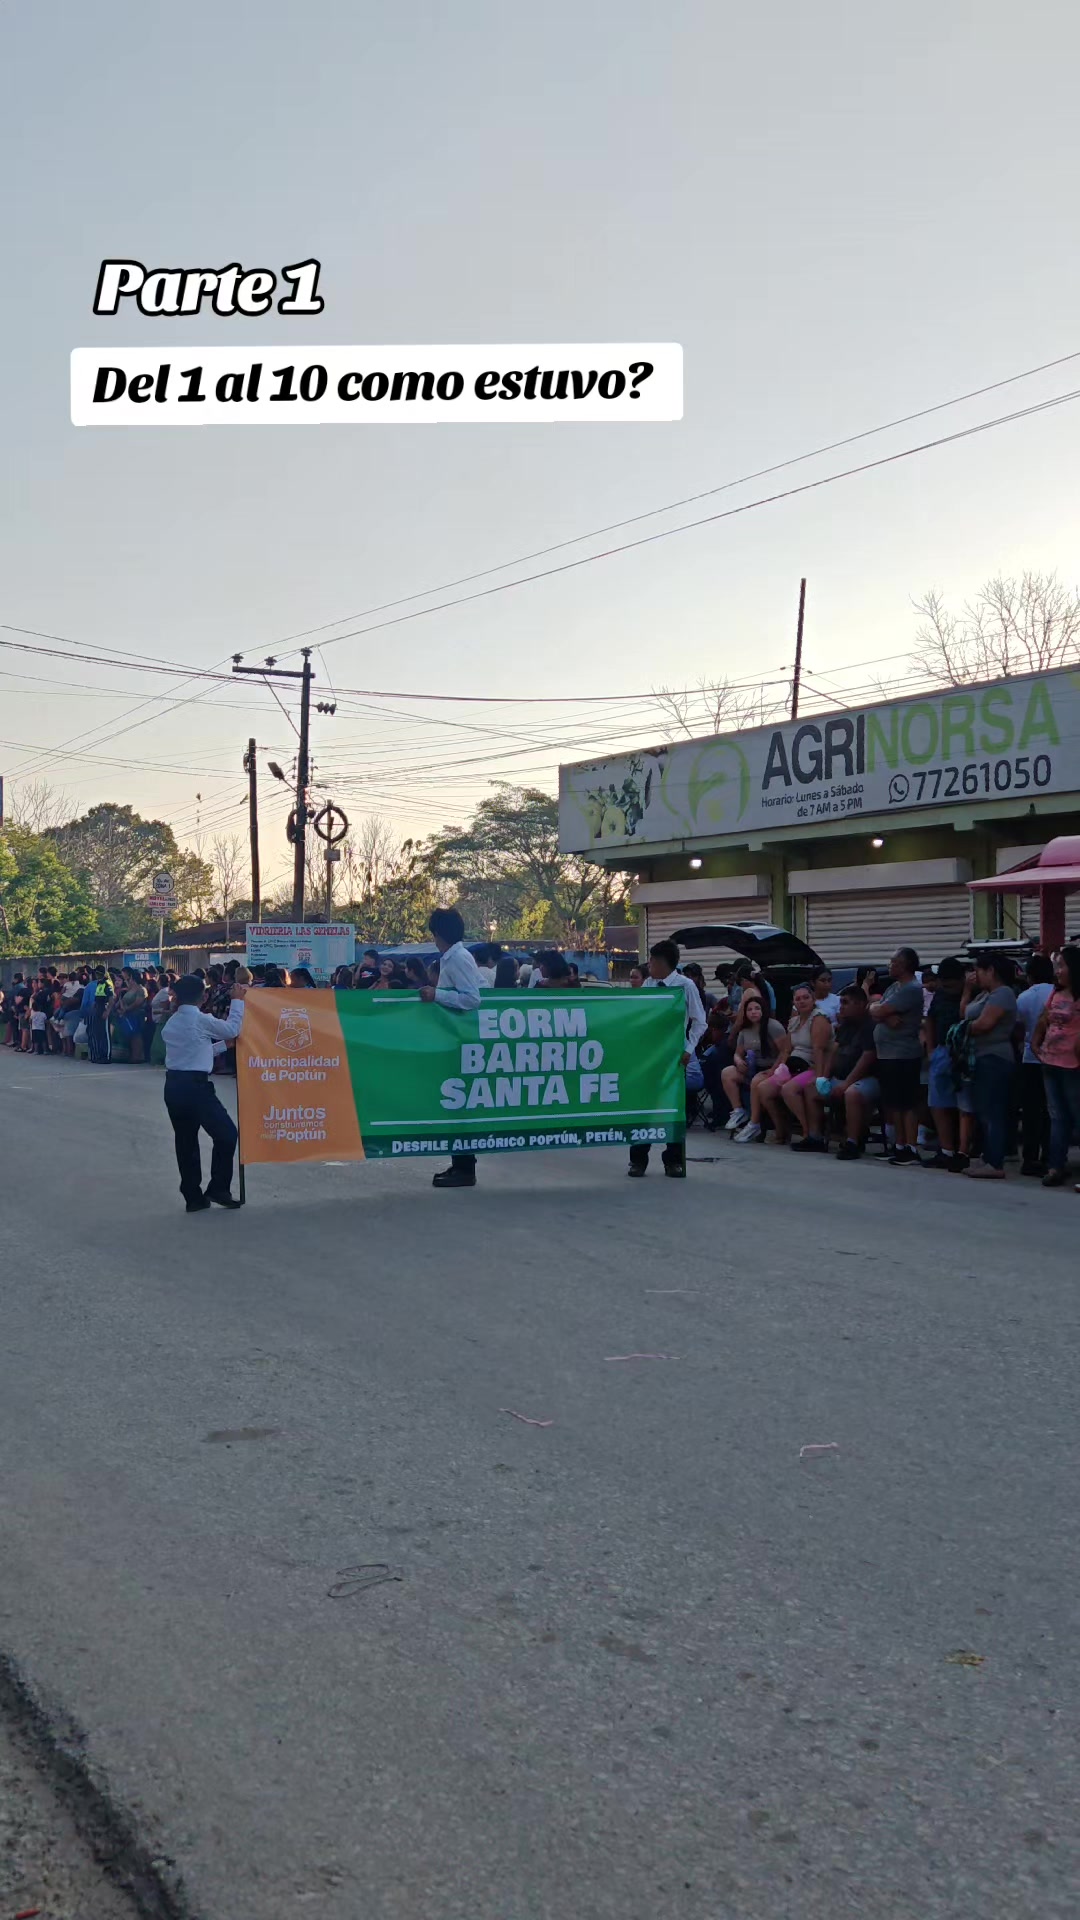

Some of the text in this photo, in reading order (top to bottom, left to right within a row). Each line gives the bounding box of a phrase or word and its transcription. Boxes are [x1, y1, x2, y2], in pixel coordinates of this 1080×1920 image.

[761, 680, 1061, 790] AGRINORSA
[912, 754, 1051, 800] 77261050
[762, 782, 864, 808] Horario: Lunes a Sábado
[797, 797, 863, 817] de 7 AM a 5 PM
[249, 926, 350, 936] VIDRIERIA LAS GEMELAS
[478, 1008, 587, 1040] EORM
[248, 1055, 340, 1069] Municipalidad
[460, 1040, 603, 1075] BARRIO
[261, 1068, 327, 1083] de Poptún
[440, 1073, 620, 1110] SANTA FE
[263, 1104, 327, 1121] Juntos
[277, 1128, 327, 1143] Poptún
[392, 1127, 666, 1153] DESFILE ALEGÓRICO POPTÚN, PETÉN, 2026
